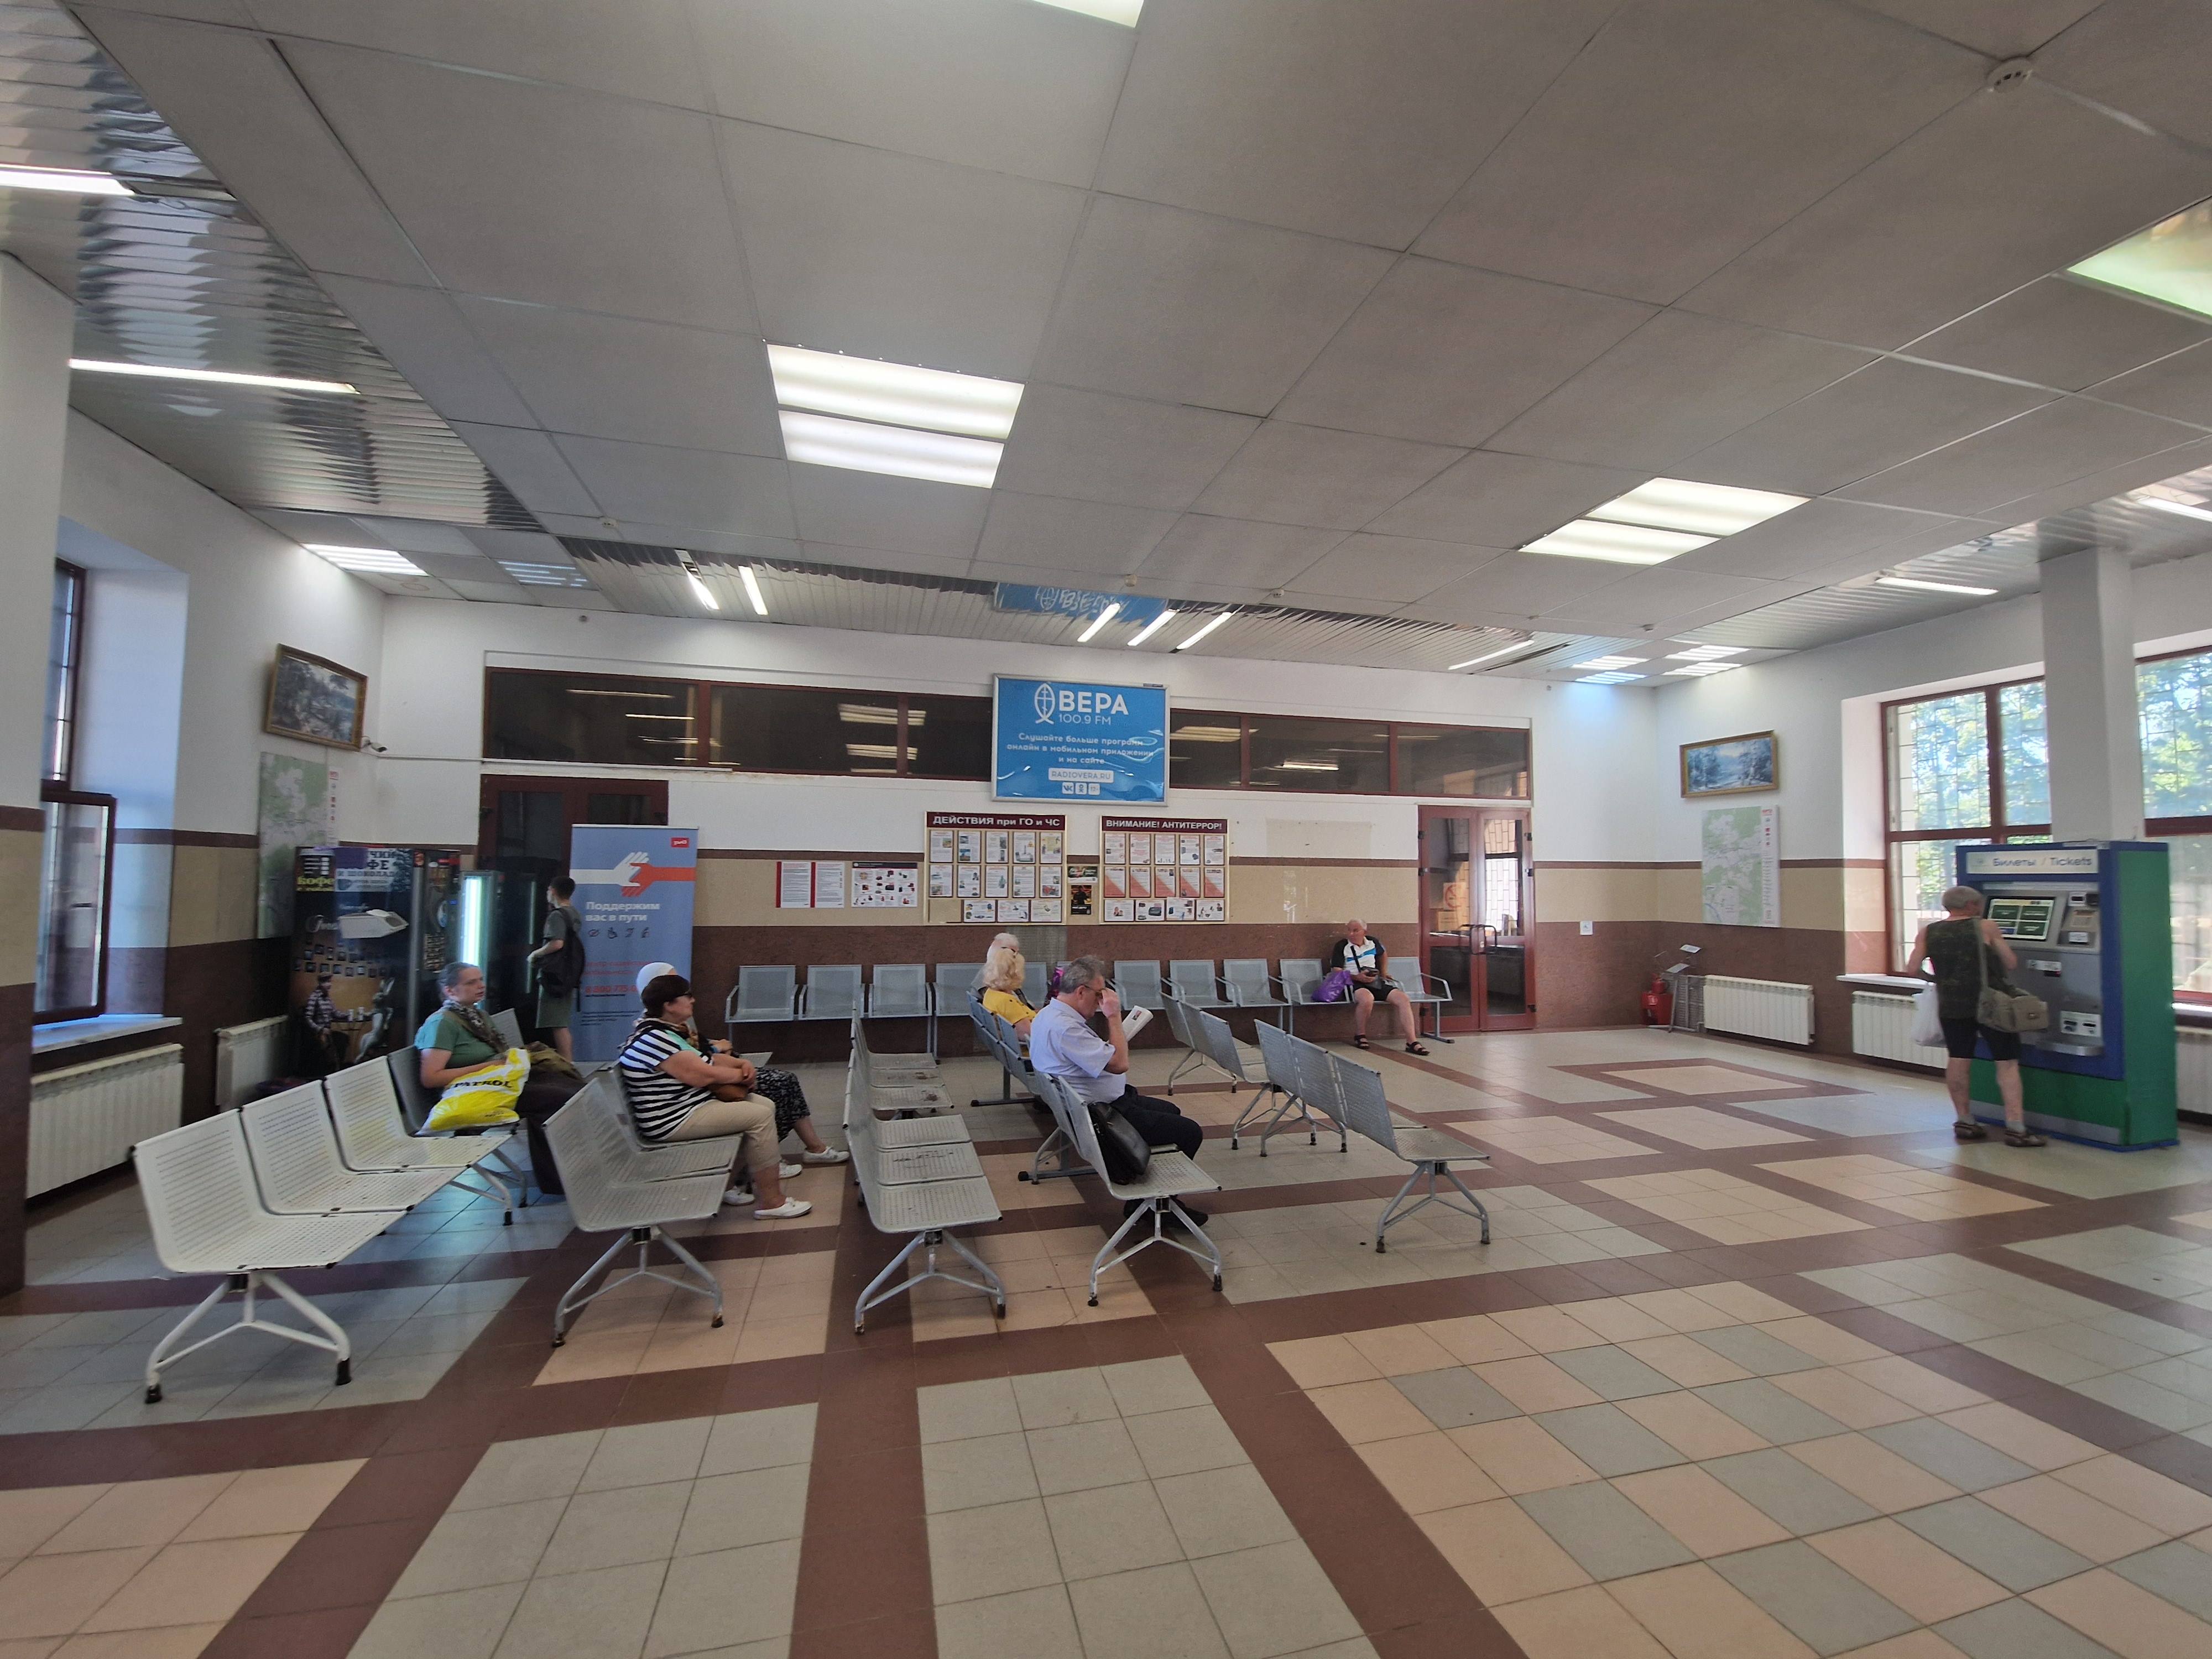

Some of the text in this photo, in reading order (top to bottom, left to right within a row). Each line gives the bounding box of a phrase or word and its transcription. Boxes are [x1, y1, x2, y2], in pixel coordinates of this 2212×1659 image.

[1058, 691, 1129, 715] ВЕРА
[1058, 714, 1112, 726] 100.9 FM
[1018, 733, 1143, 747] Слушайте больше программ
[1006, 743, 1039, 752] онлайн
[1050, 745, 1098, 754] мобильном
[1100, 748, 1154, 757] приложении
[1051, 770, 1111, 780] RADIOVERA.RU
[933, 816, 994, 825] ДЕЙСТВИЯ
[1106, 820, 1222, 830] ВНИМАНИЕ! АНТИТЕРРОР!
[2050, 857, 2092, 866] Tickets
[586, 901, 660, 912] Поддержим
[618, 913, 648, 923] пути
[454, 1079, 512, 1088] PATROL
